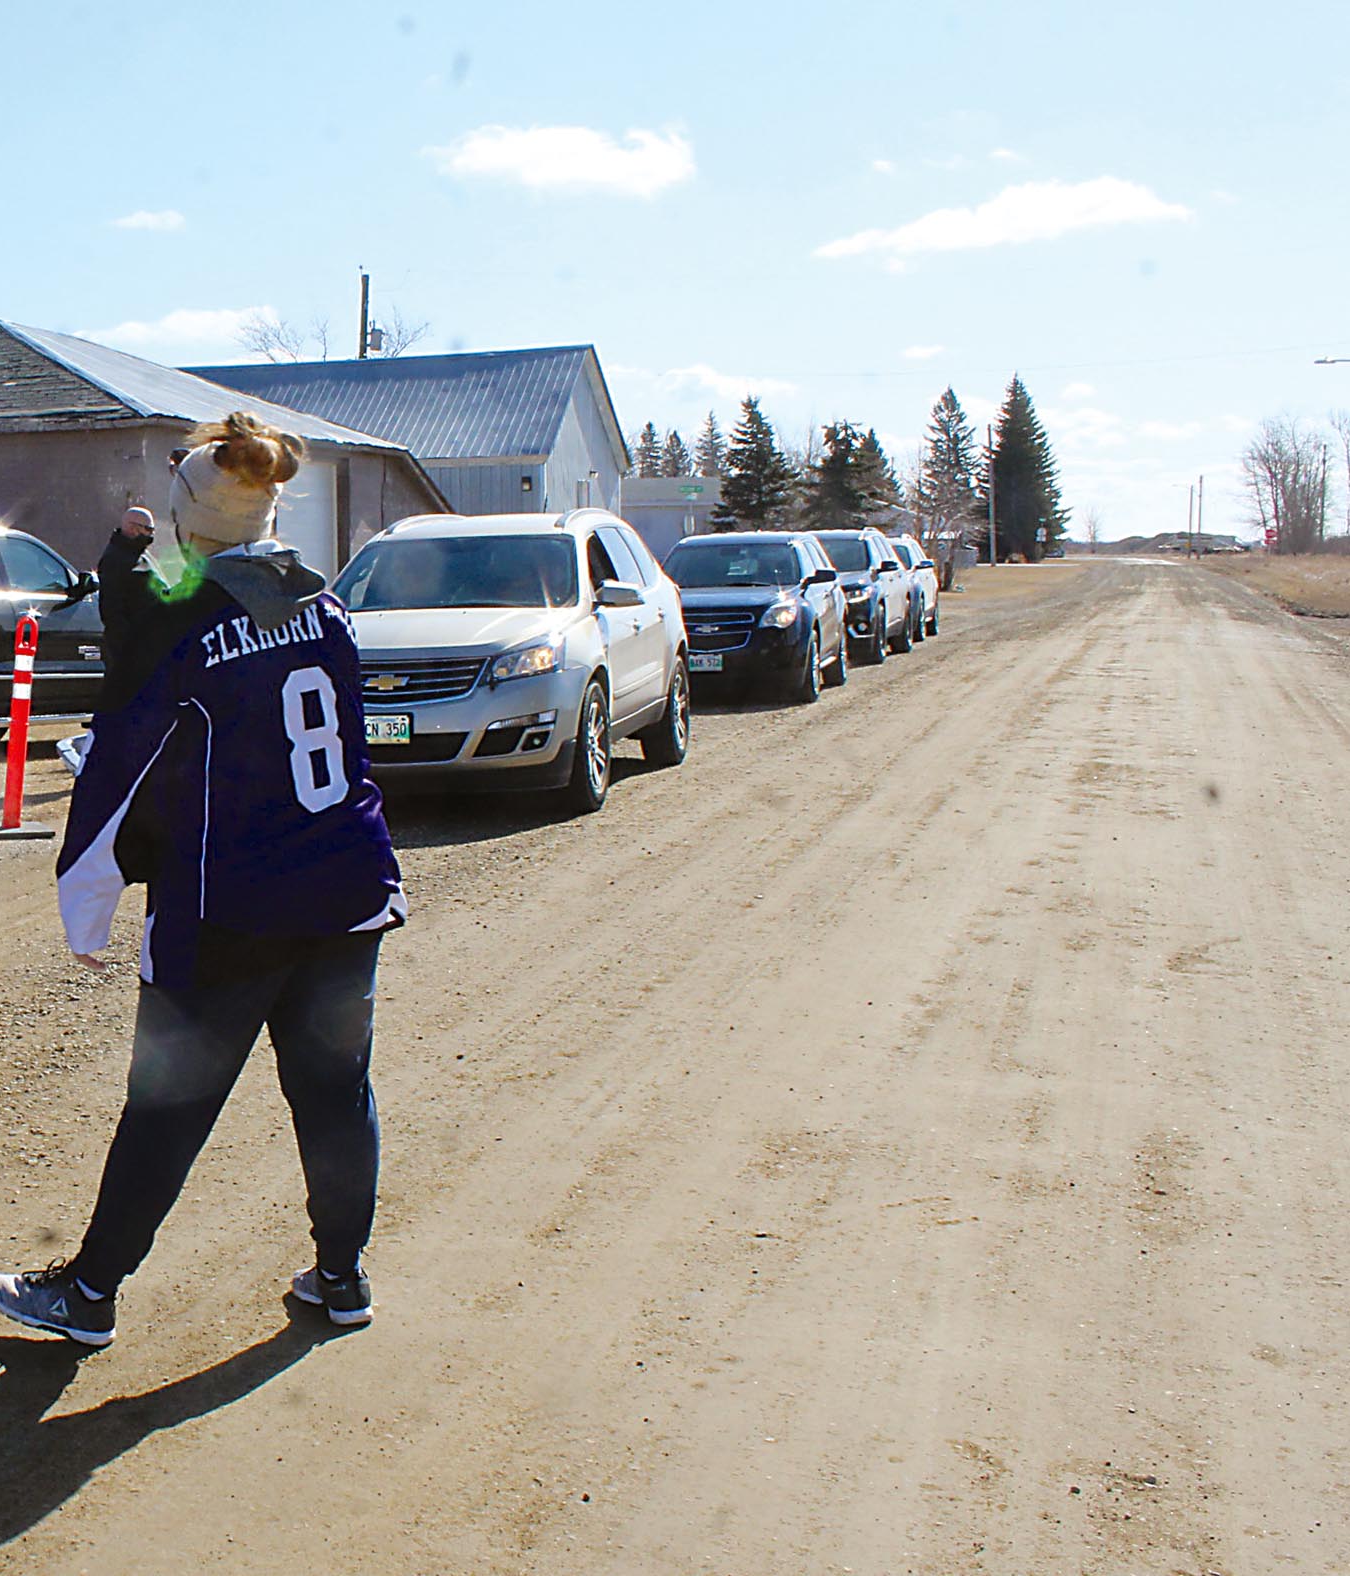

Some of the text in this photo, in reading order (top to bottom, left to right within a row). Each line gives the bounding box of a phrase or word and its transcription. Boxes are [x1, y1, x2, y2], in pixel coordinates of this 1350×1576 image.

[198, 603, 324, 668] ELKHORN
[282, 666, 349, 813] 8
[364, 722, 407, 737] CN 350
